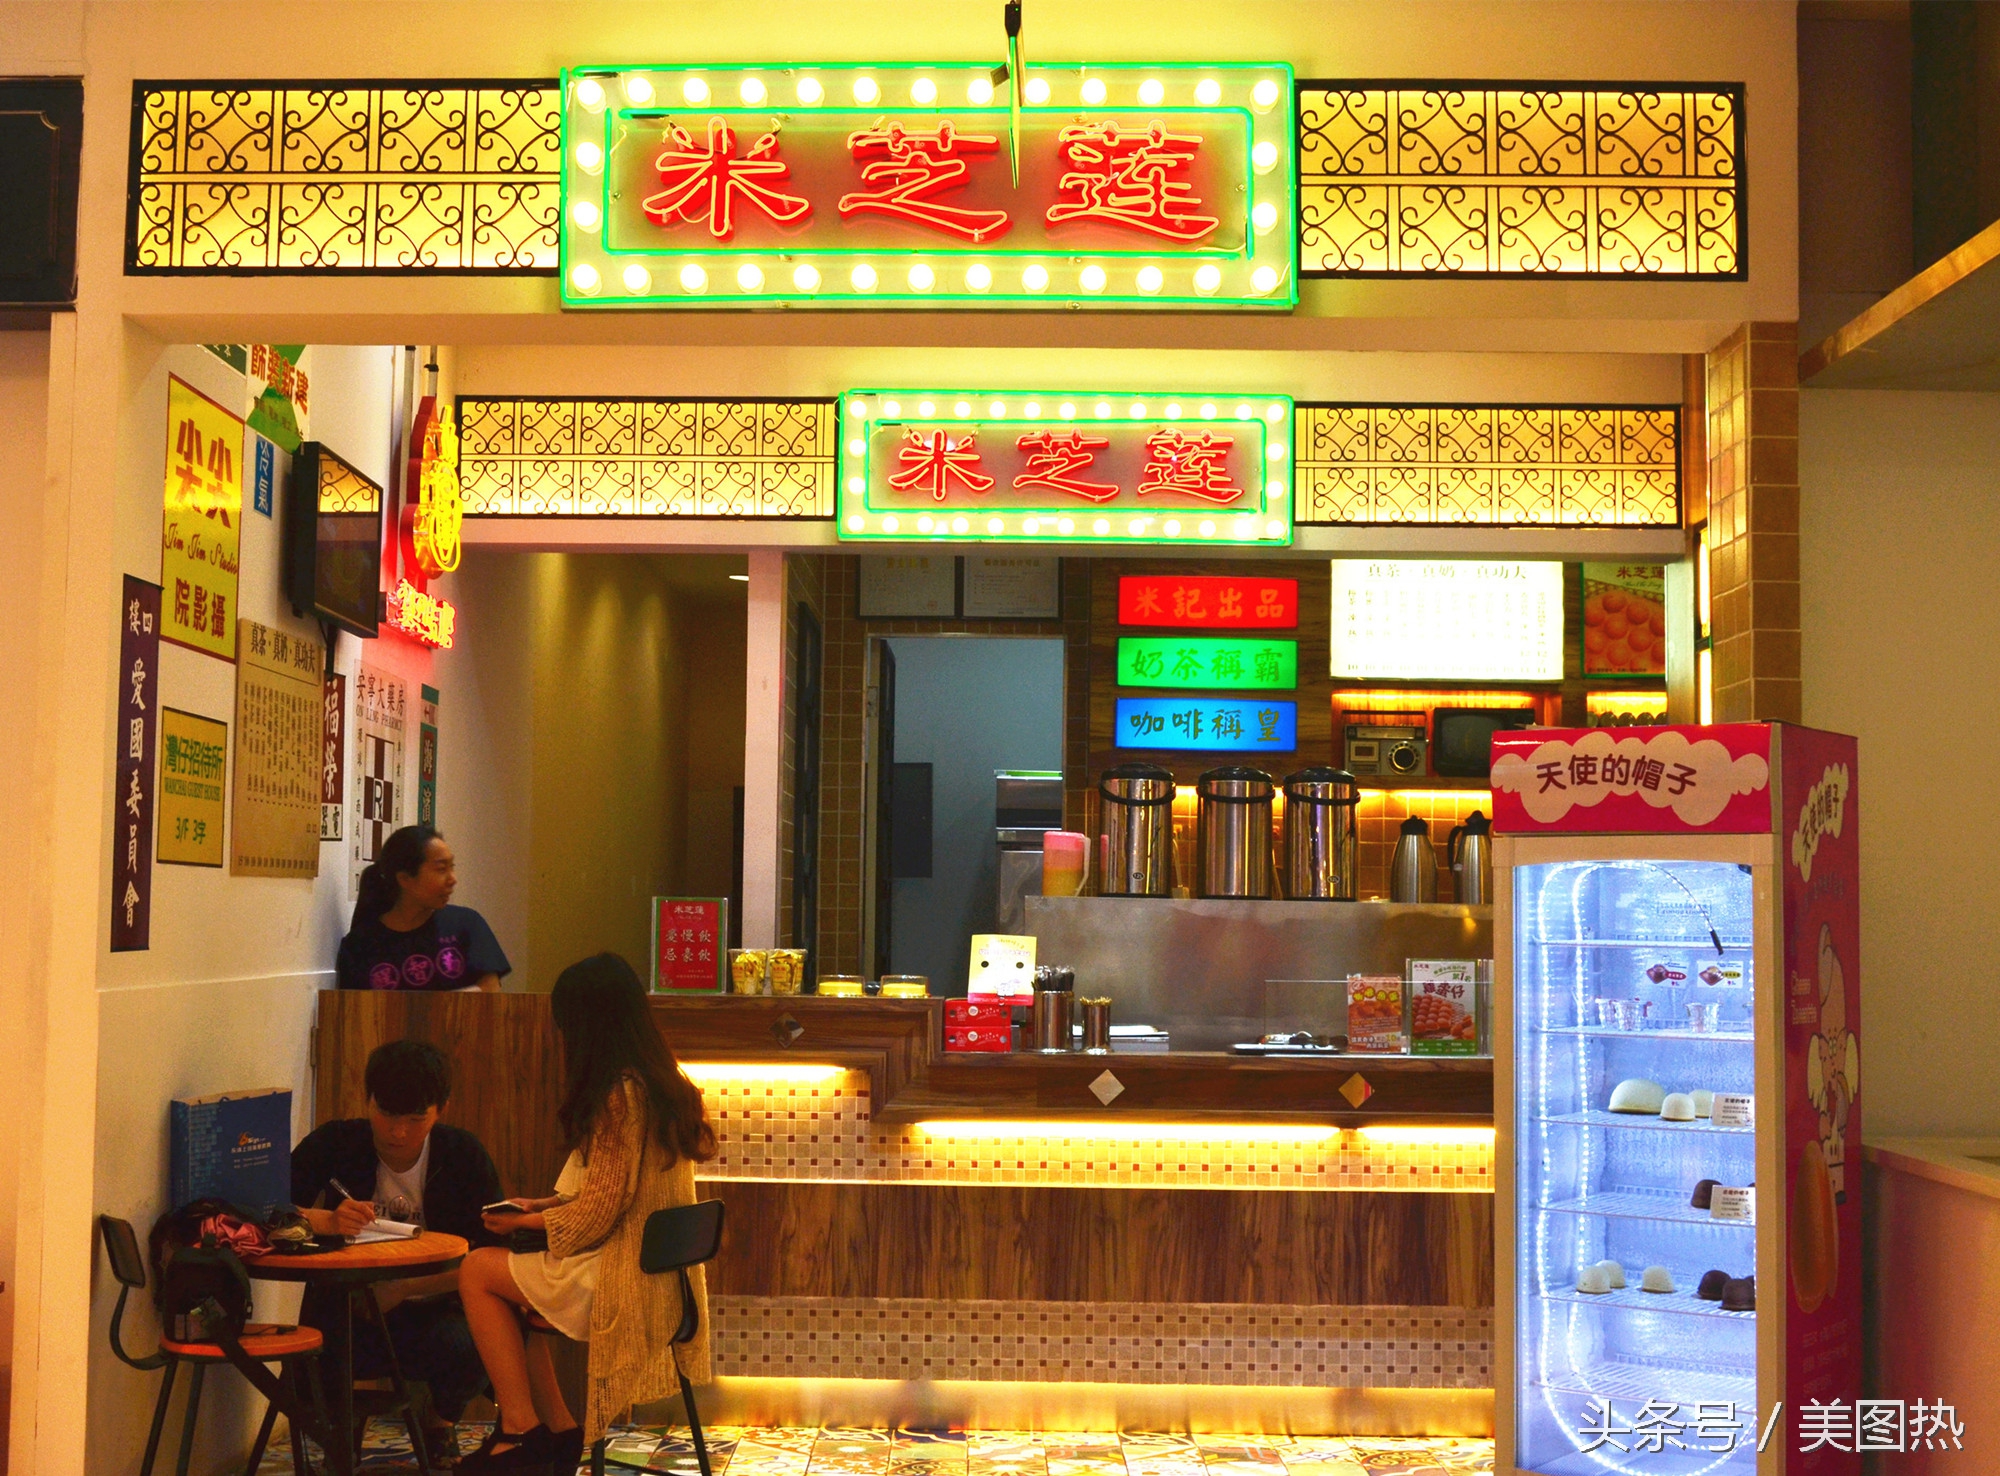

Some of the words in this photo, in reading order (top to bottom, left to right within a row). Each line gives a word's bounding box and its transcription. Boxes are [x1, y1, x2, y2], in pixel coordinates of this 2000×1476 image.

[1132, 585, 1285, 619] 米記出品
[1130, 647, 1282, 683] 奶茶稱霸
[1130, 707, 1282, 743] 咖啡稱皇
[164, 733, 224, 781] 灣仔招待所
[1536, 754, 1698, 796] 天使的帽子
